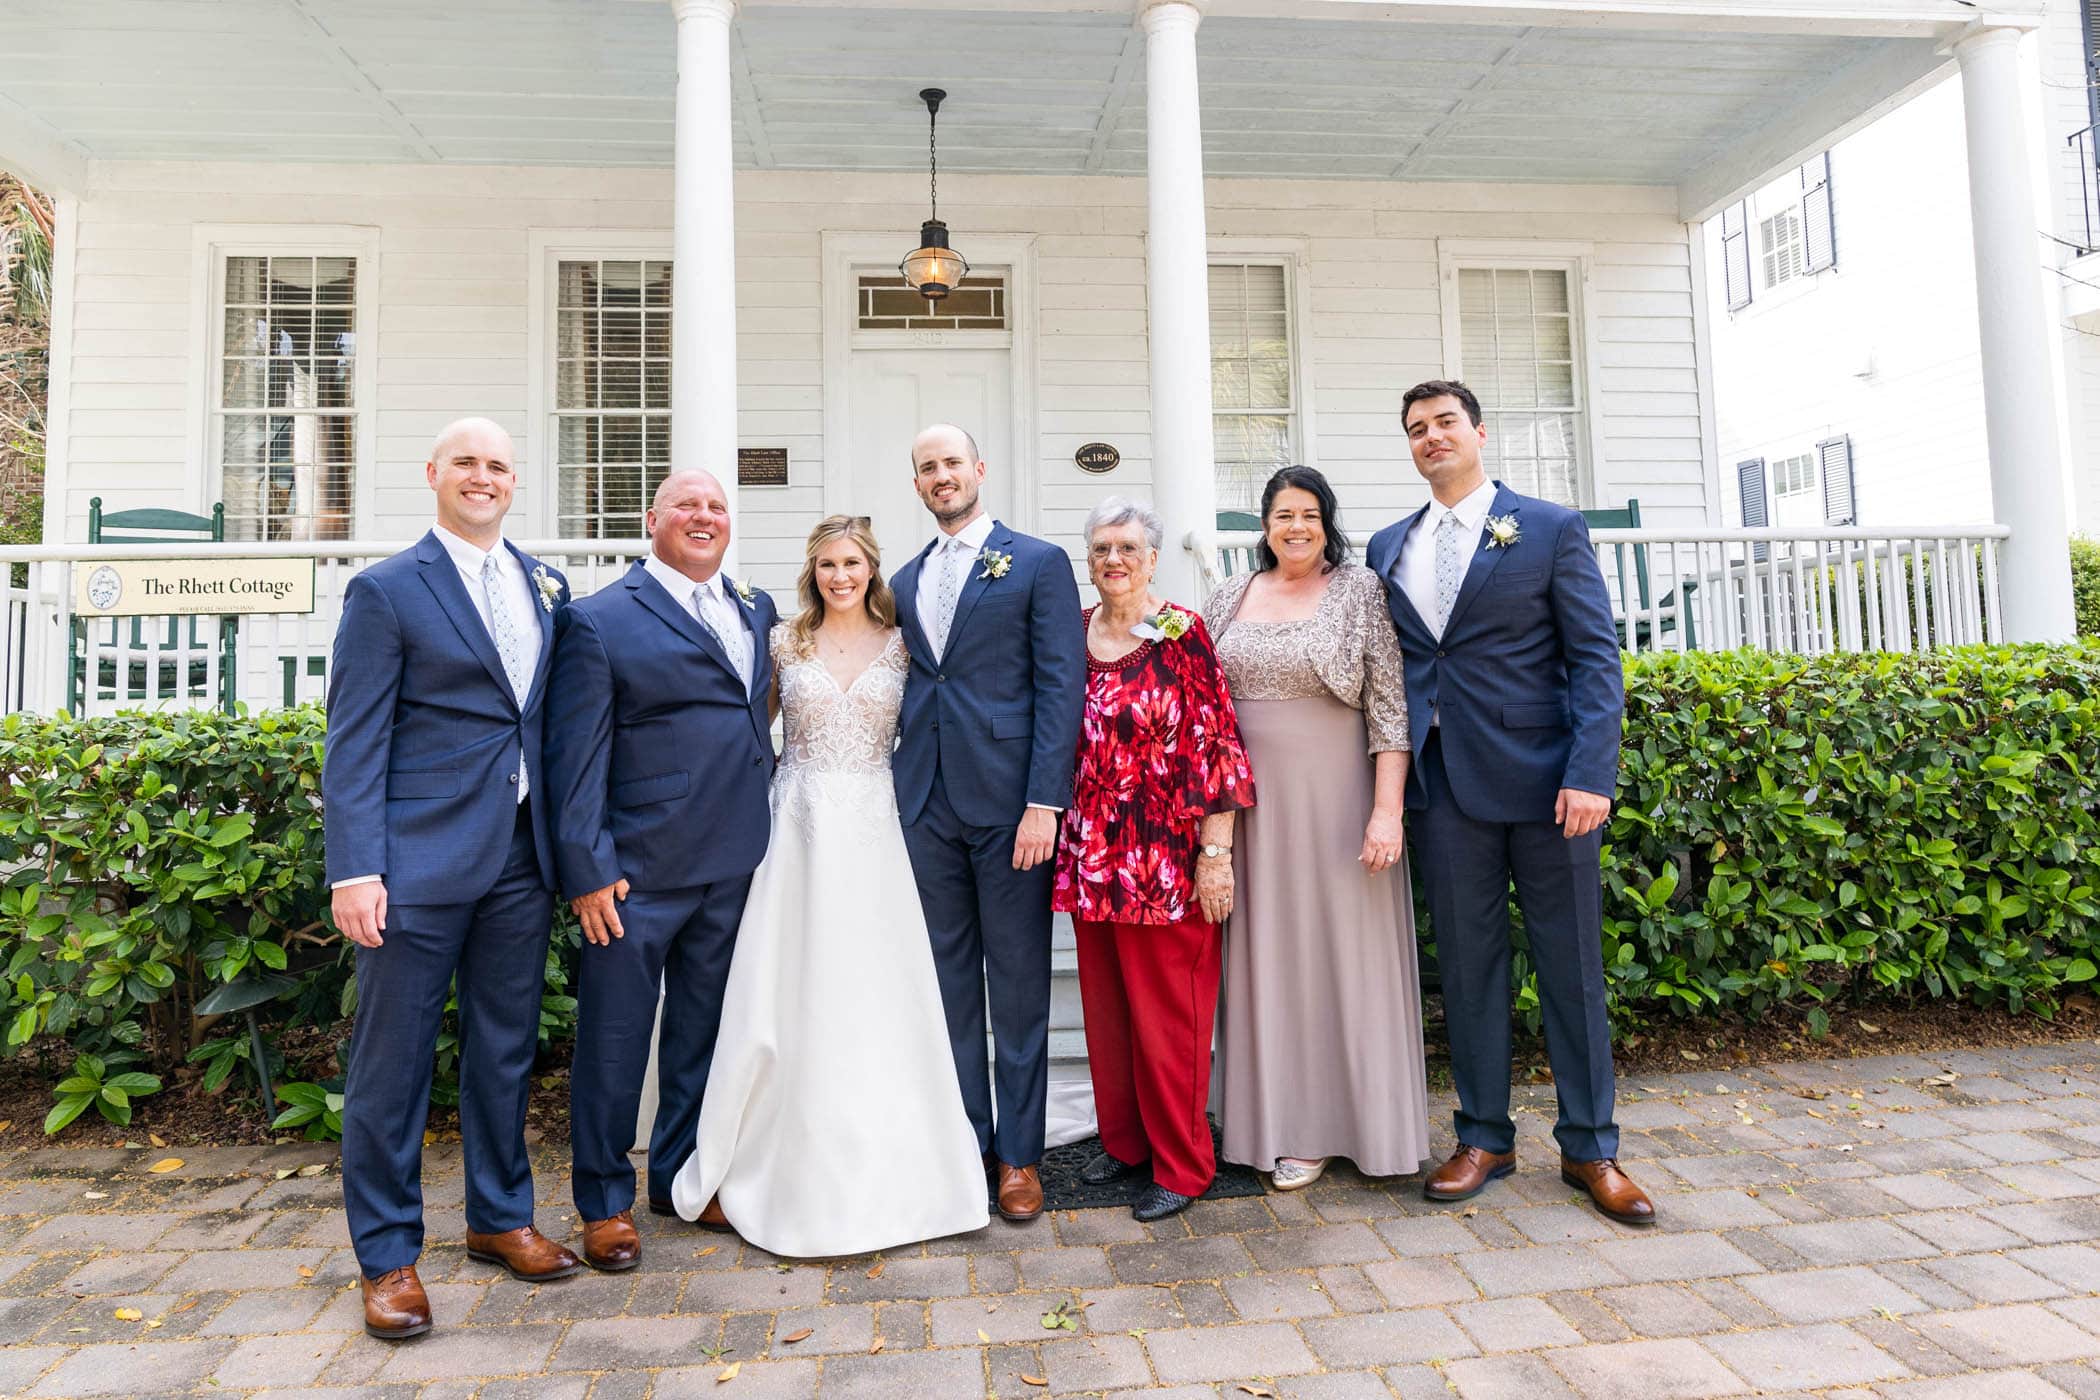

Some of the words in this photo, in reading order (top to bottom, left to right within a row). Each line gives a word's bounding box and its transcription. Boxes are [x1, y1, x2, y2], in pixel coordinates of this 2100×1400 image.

[141, 578, 175, 595] The
[179, 578, 224, 594] Rhett
[229, 577, 294, 600] Cottage
